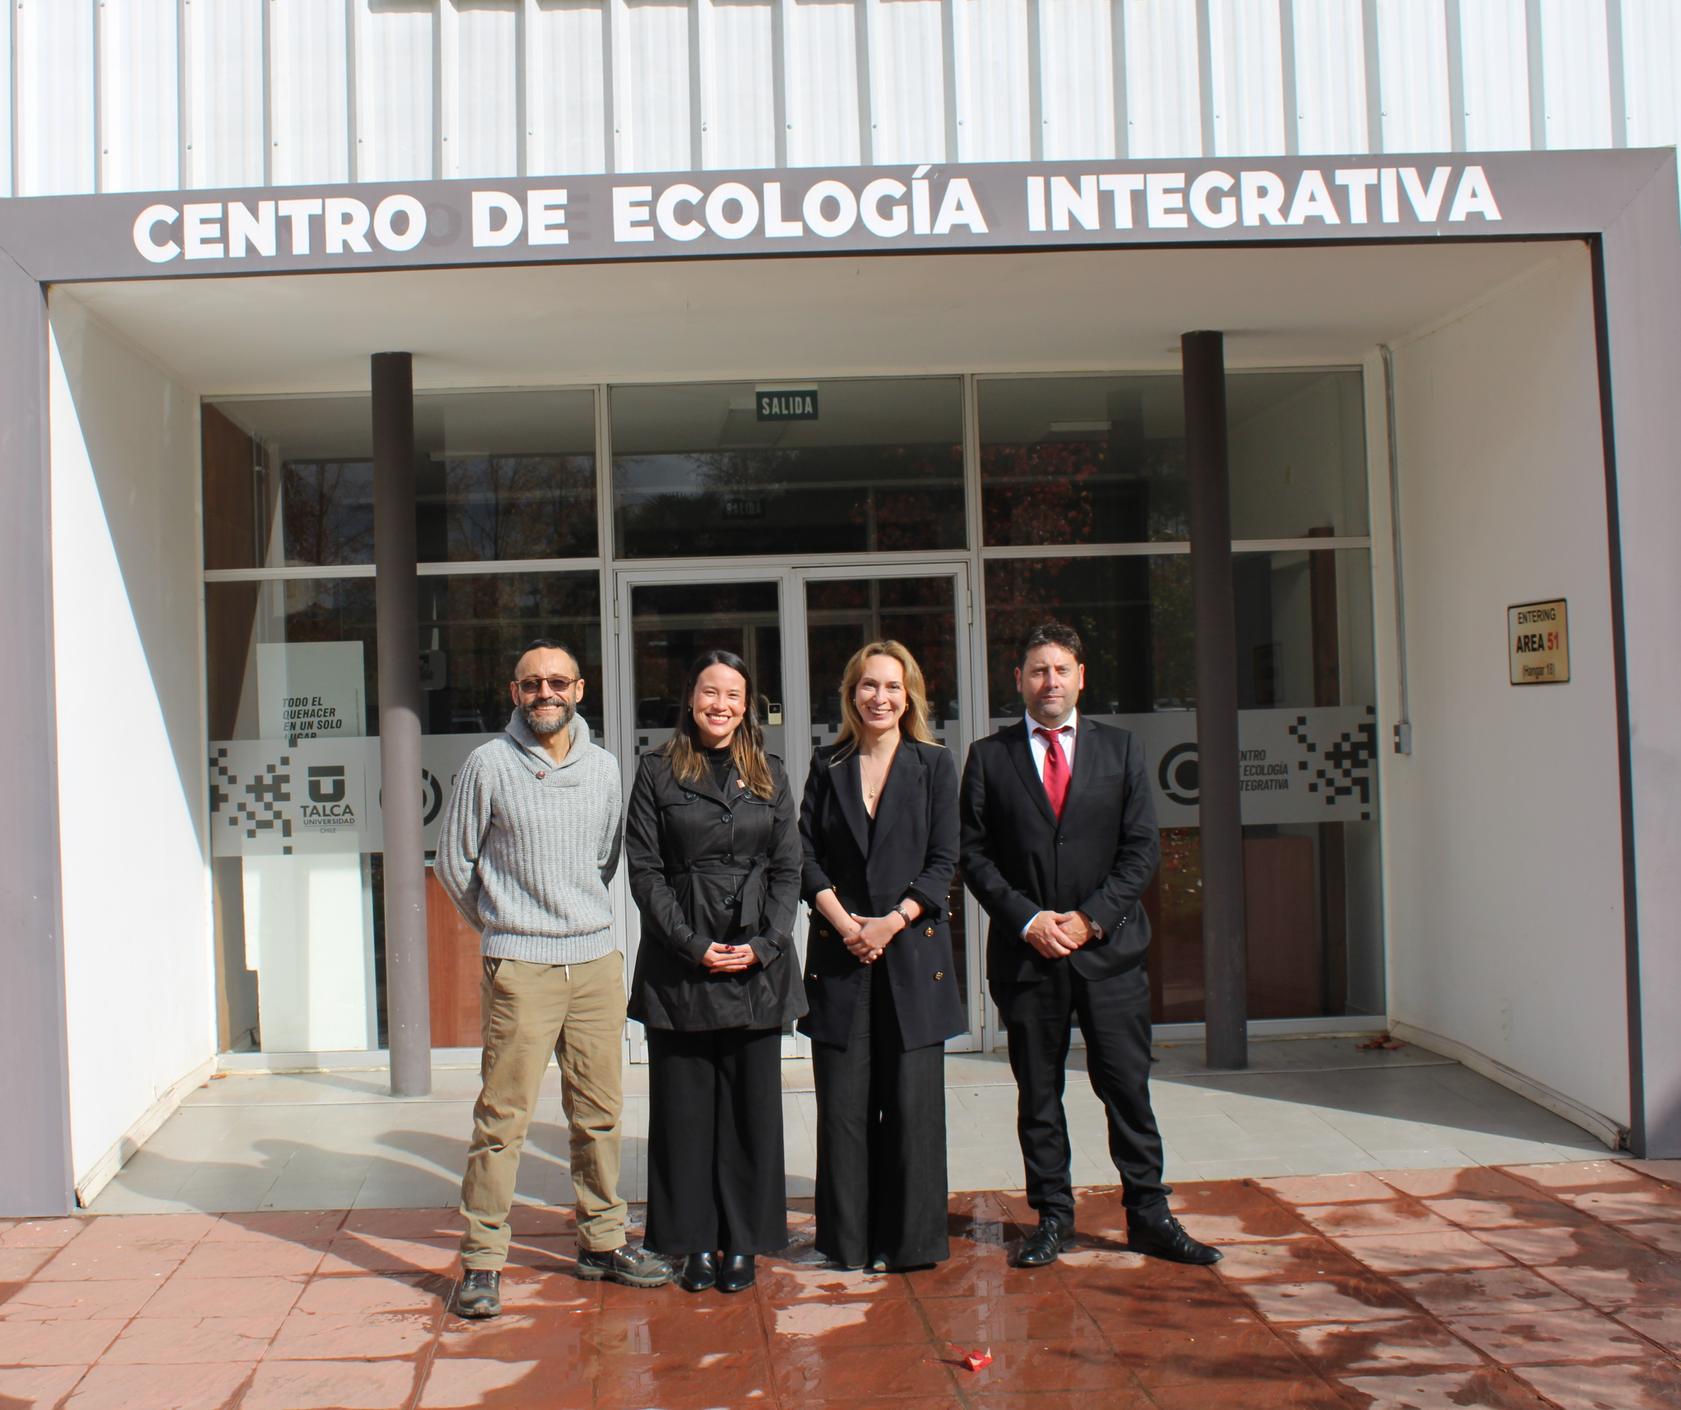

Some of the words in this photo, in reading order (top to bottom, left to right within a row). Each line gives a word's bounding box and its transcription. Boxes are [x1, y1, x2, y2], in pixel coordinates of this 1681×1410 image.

[133, 194, 427, 263] CENTRO
[472, 189, 569, 248] DE
[611, 164, 989, 244] ECOLOGÍA
[1027, 165, 1502, 232] INTEGRATIVA
[761, 397, 813, 415] SALIDA
[1517, 607, 1556, 625] ENTERING
[1516, 633, 1545, 653] AREA
[1547, 632, 1559, 651] 51
[283, 697, 309, 708] TODO
[311, 696, 323, 706] EL
[283, 707, 336, 720] QUEHACER
[284, 721, 297, 731] EN
[300, 720, 314, 731] UN
[316, 719, 343, 730] SOLO
[1240, 749, 1267, 761] NTRO
[1240, 778, 1289, 792] TEGRATIVA
[300, 804, 355, 818] TALCA
[303, 817, 356, 826] UNIVERSIDAD
